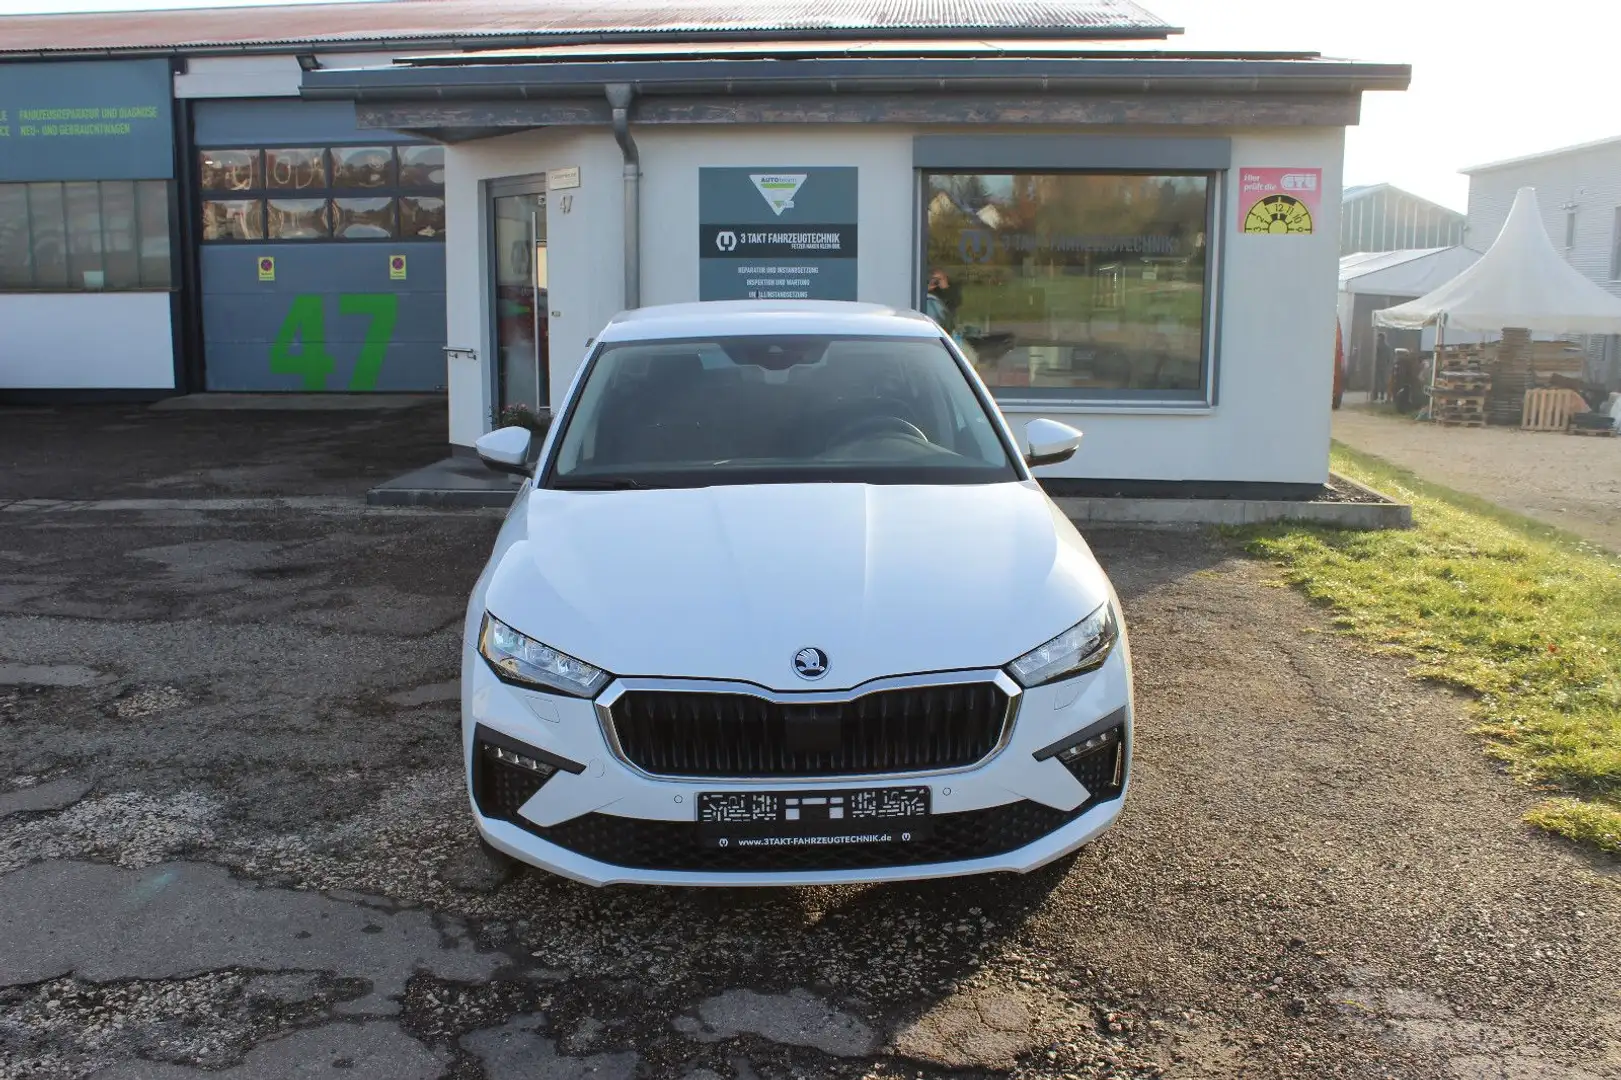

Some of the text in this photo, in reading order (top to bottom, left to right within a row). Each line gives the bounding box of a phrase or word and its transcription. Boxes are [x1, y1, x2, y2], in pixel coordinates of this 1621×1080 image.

[101, 107, 117, 119] UND
[118, 106, 157, 119] DIAGNOSE
[20, 122, 130, 136] NEU- UND GEBRAUCHTWAGEN
[1243, 173, 1260, 182] Hier
[1264, 183, 1277, 191] die
[559, 194, 573, 214] 47
[1275, 203, 1284, 212] 12
[740, 232, 840, 243] 3 TAKT FAHRZEUGTECHNIK
[269, 293, 398, 392] 47
[738, 834, 892, 846] www.3TAKT-FAHRZEUGTECHNIK.de
